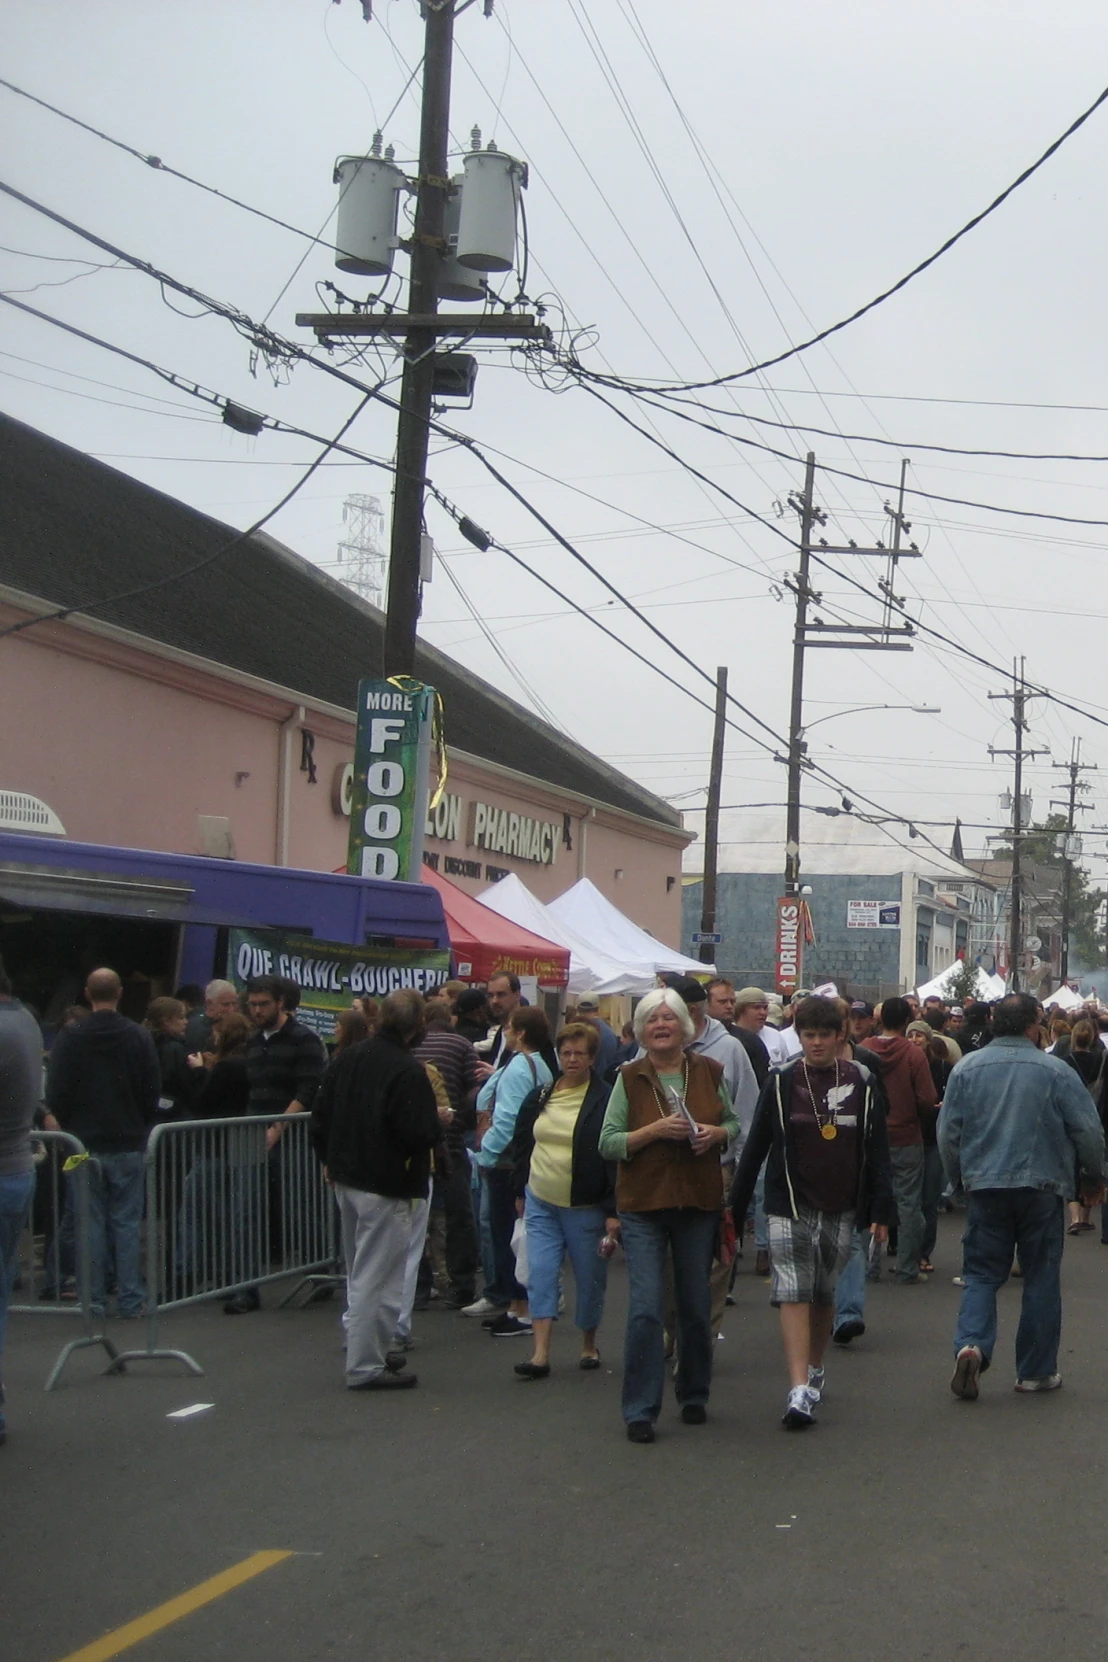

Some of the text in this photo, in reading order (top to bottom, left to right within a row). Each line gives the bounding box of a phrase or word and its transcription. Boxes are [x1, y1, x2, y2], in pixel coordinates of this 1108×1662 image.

[366, 692, 413, 711] MORE
[361, 718, 406, 881] FOOD
[473, 801, 562, 866] PHARMACY
[237, 943, 273, 981] QUE
[779, 905, 798, 976] DRINKS
